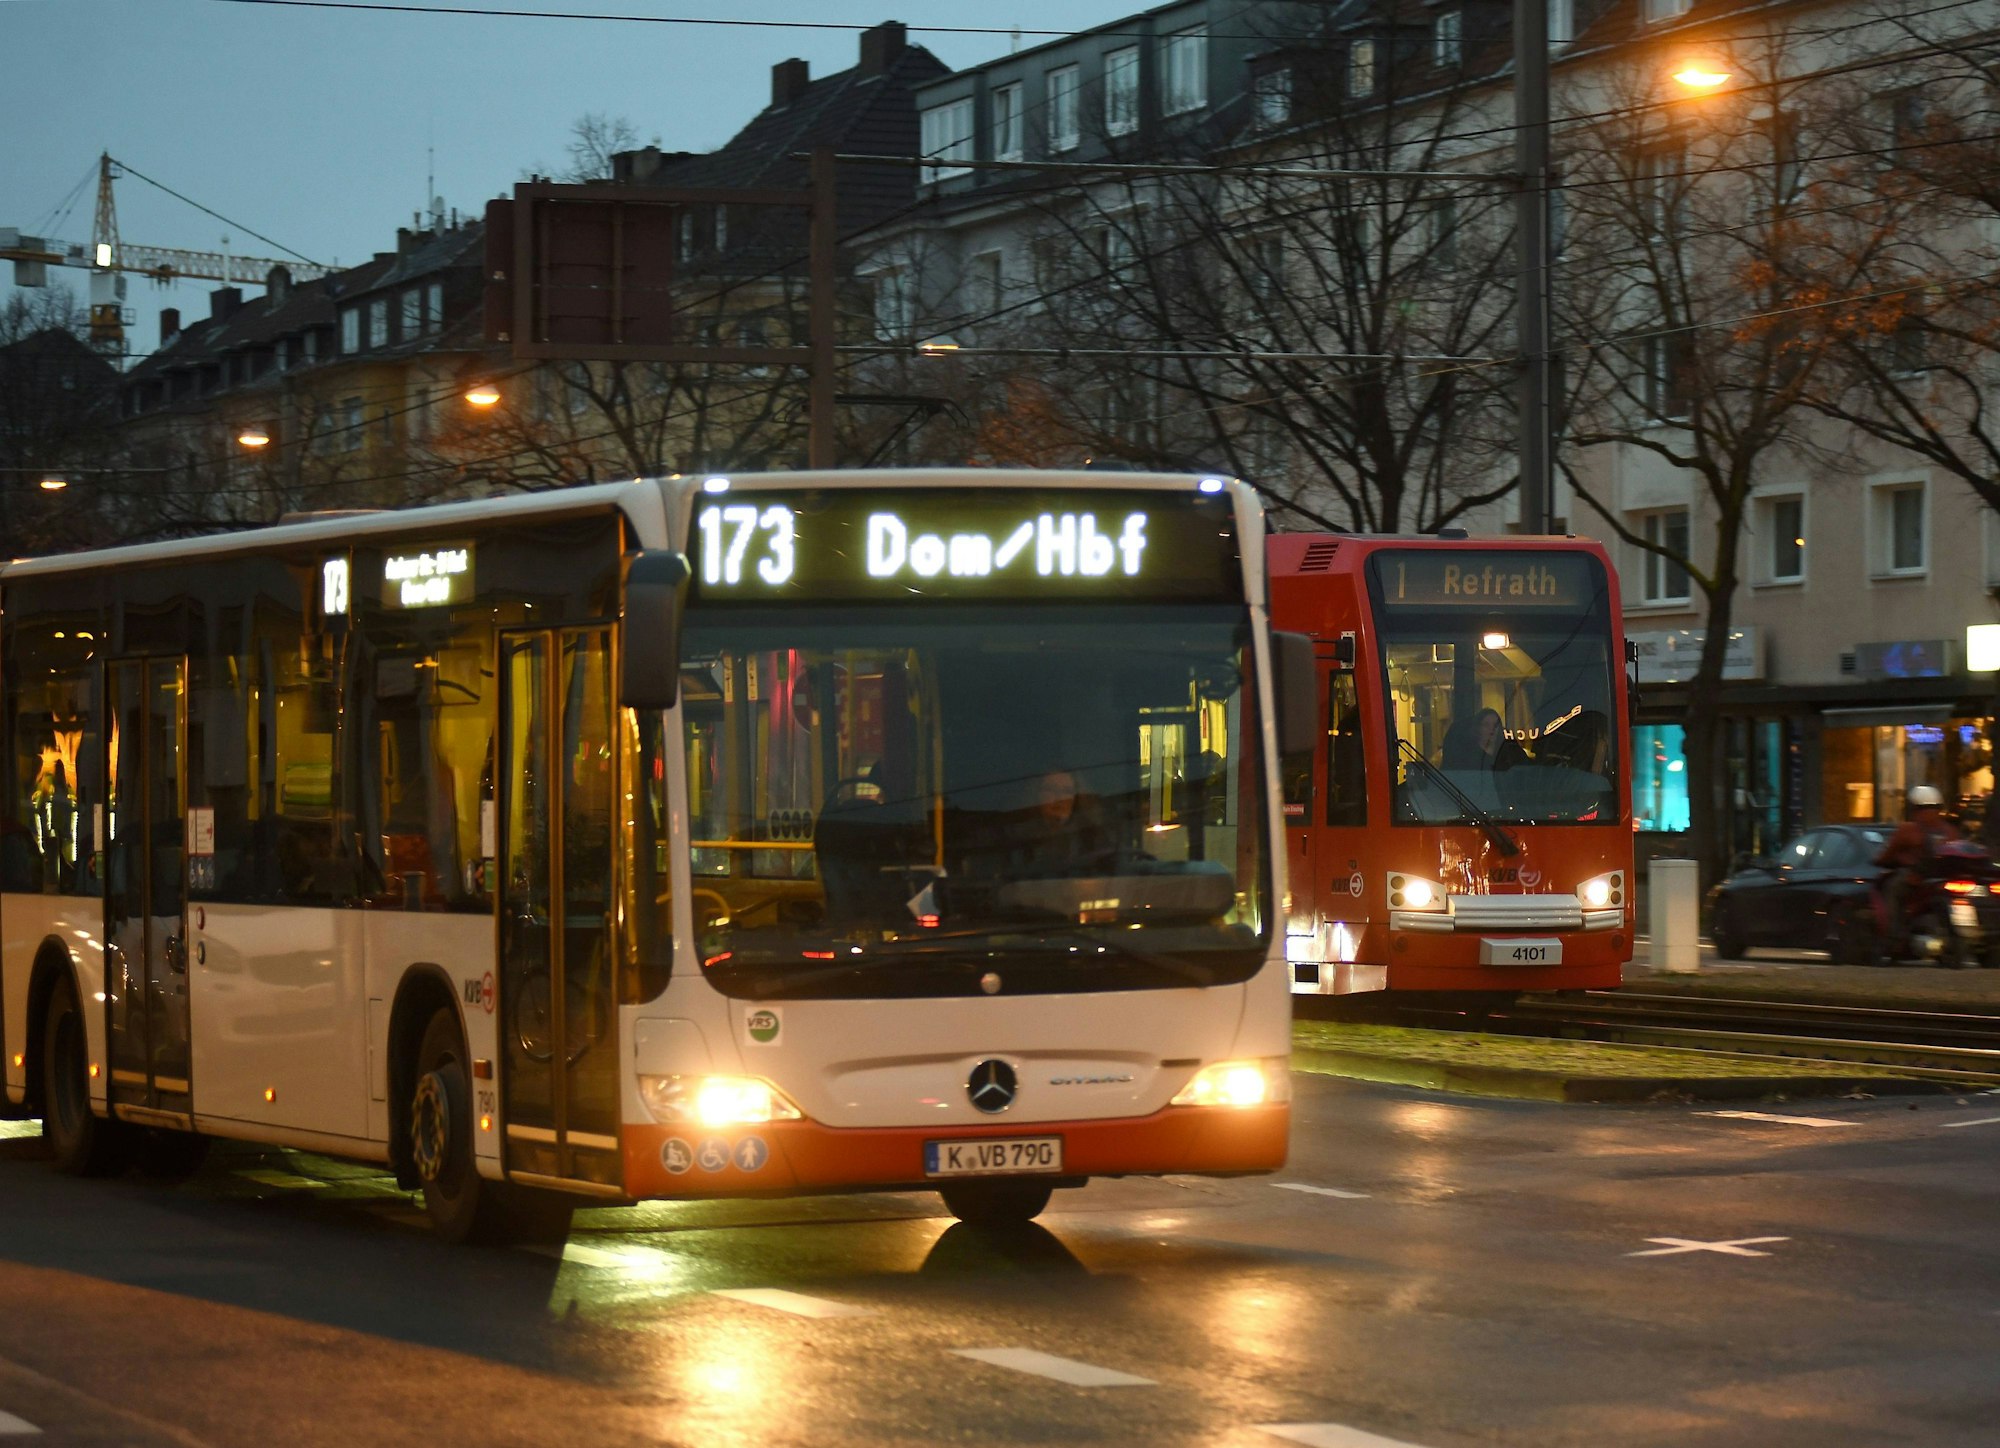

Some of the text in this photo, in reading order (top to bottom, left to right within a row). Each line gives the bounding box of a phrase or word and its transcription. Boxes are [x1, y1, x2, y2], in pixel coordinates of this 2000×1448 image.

[698, 505, 1148, 585] 173 Dom/Hbf
[1397, 562, 1556, 599] 1 Refrath
[1512, 947, 1546, 961] 4101
[747, 1017, 773, 1029] VRS
[948, 1146, 963, 1169] K
